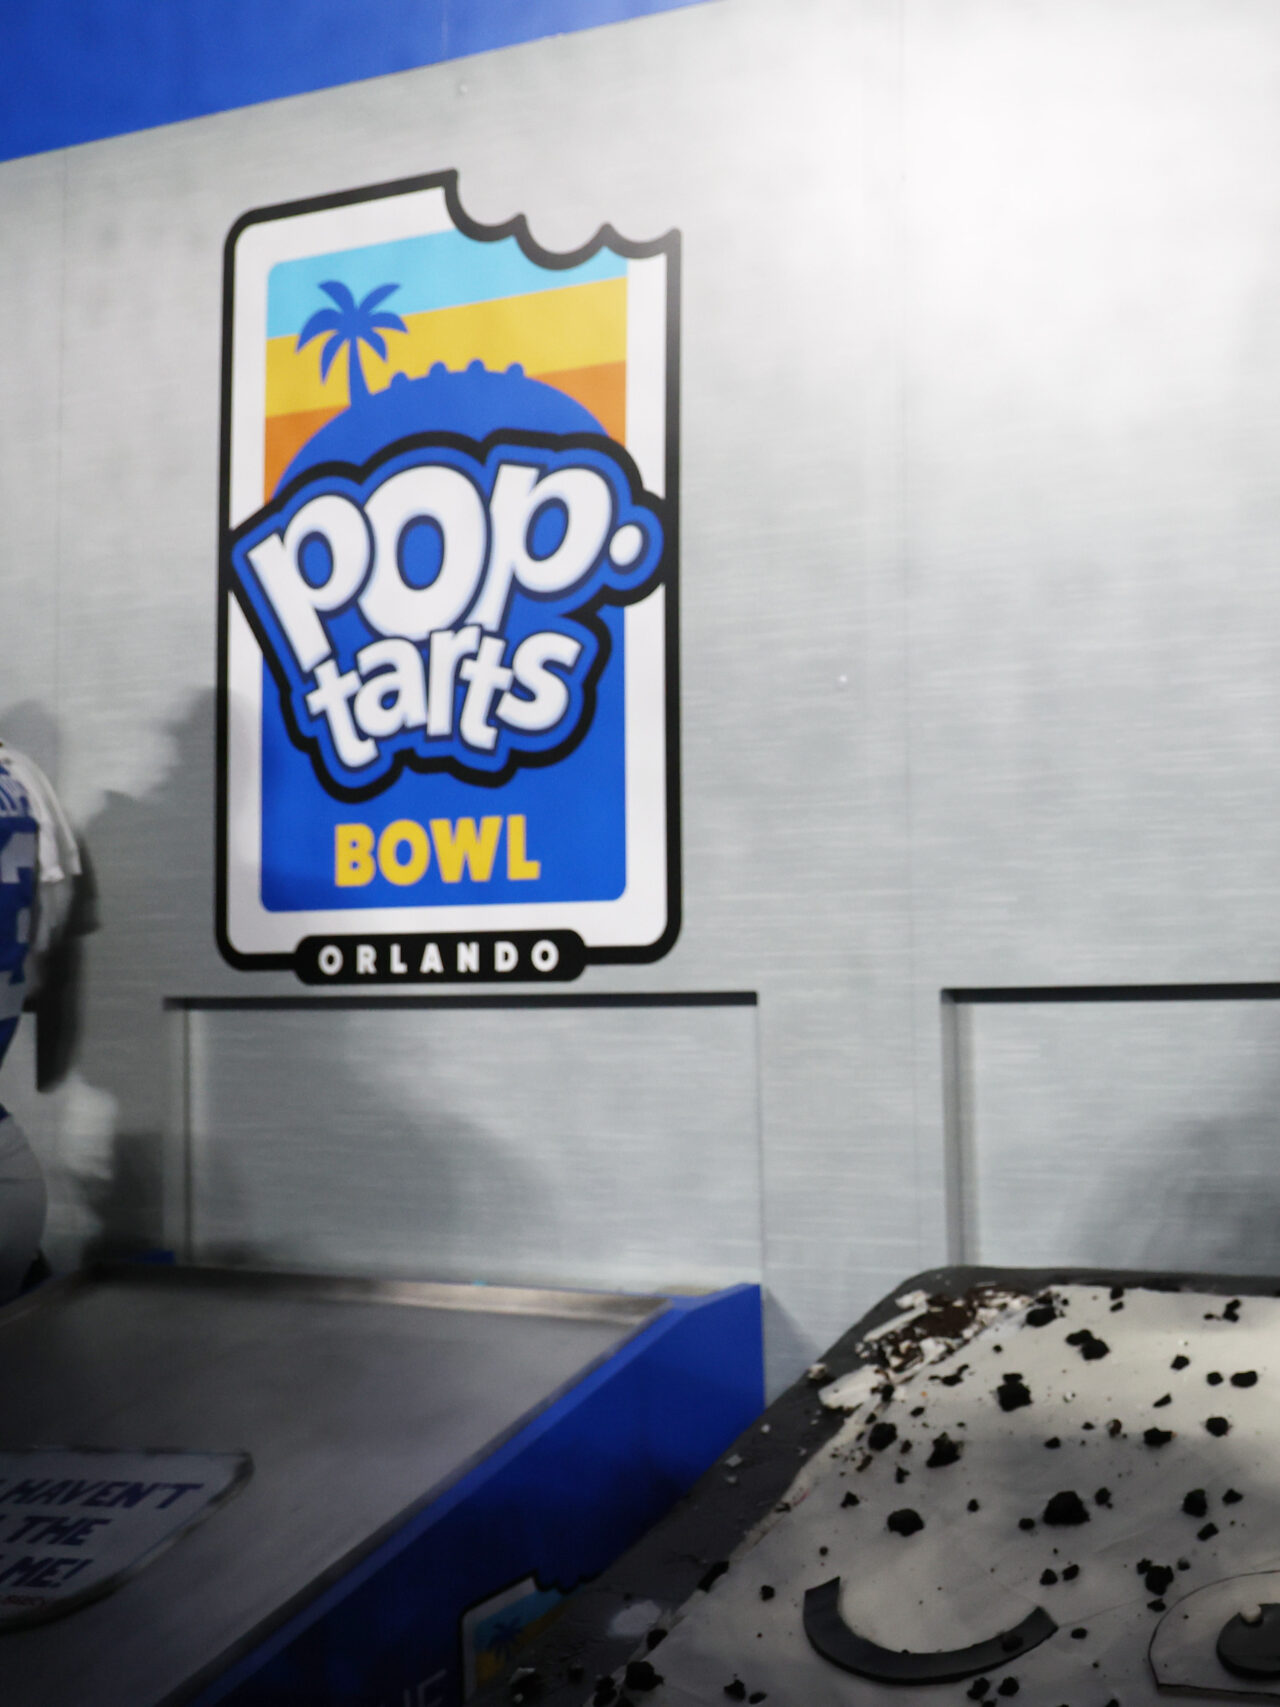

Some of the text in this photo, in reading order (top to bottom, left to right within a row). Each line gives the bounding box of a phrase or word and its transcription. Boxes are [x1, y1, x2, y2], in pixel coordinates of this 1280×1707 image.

[335, 815, 541, 888] BOWL
[317, 939, 560, 975] ORLANDO
[4, 1515, 112, 1546] THE
[0, 1556, 93, 1588] ME!
